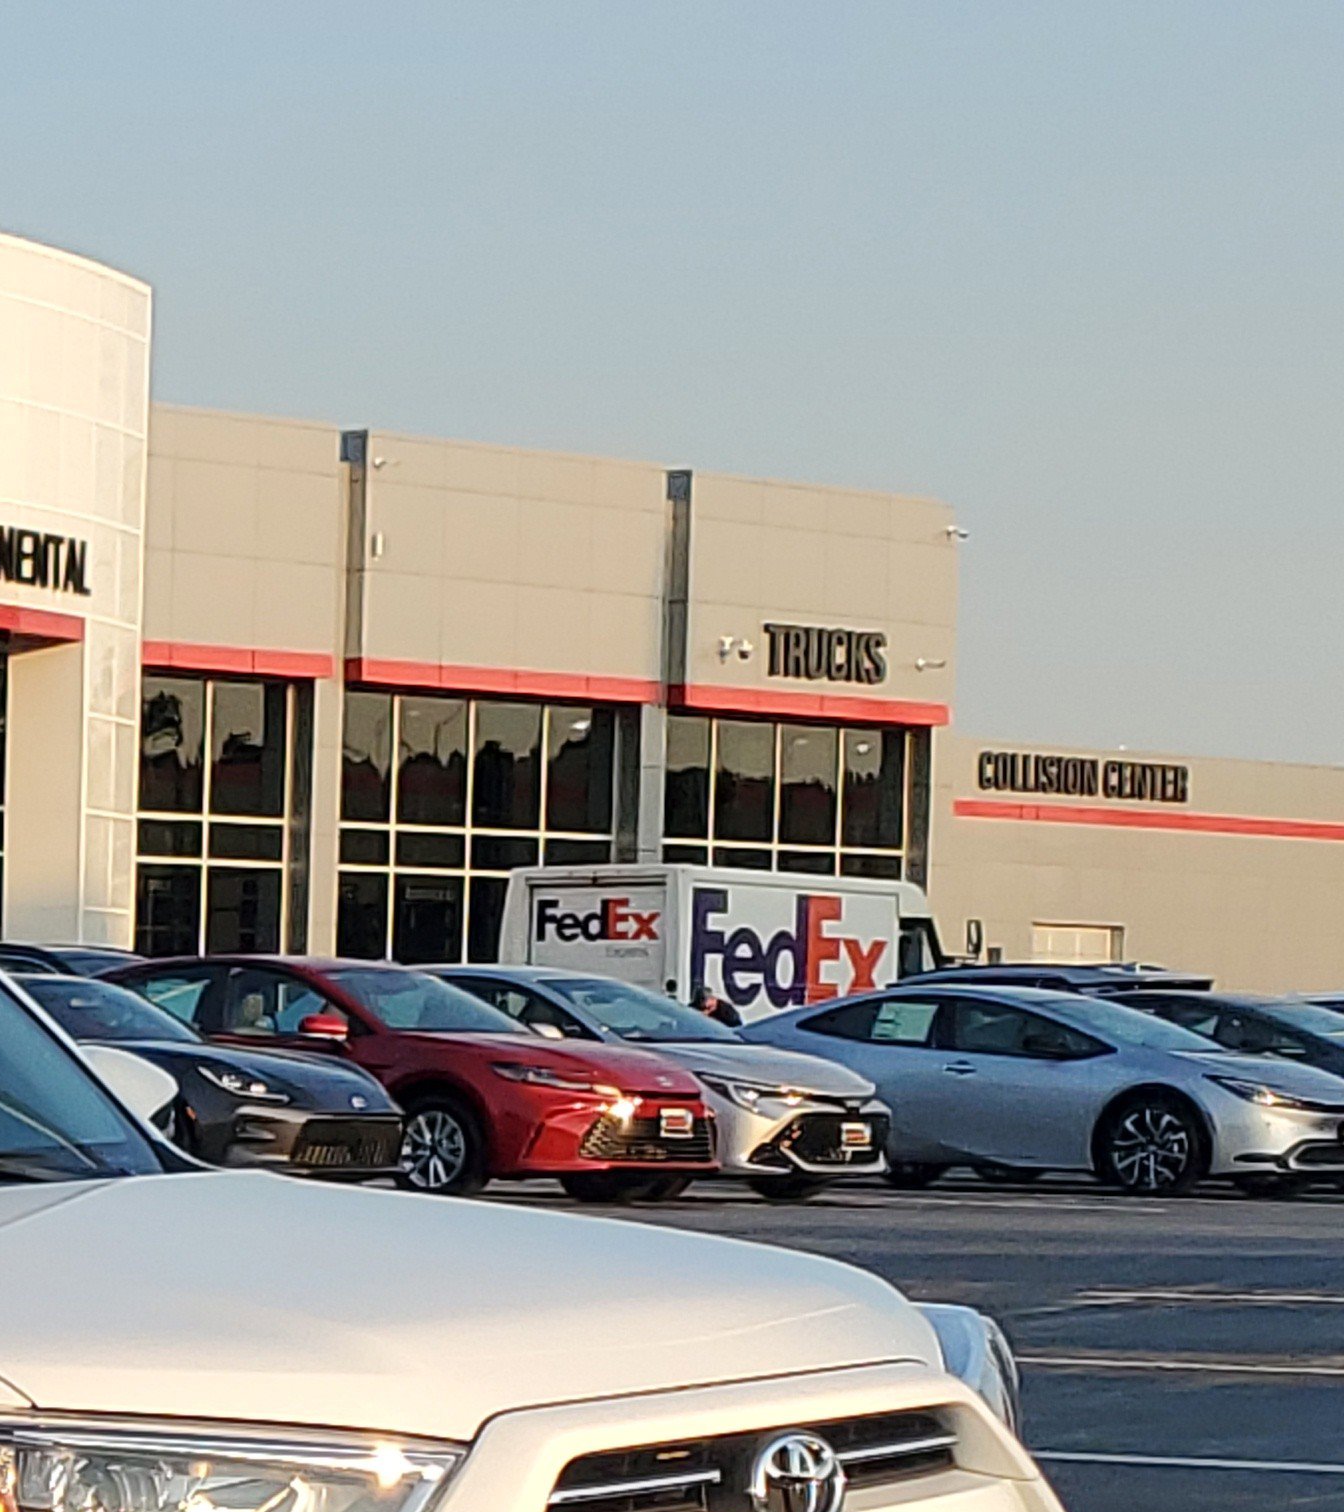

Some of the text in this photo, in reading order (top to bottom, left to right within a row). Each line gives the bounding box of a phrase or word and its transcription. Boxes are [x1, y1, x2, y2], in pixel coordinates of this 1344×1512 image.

[763, 622, 888, 685] TRUCKS
[978, 750, 1189, 803] COLLISION CENTER
[537, 898, 661, 942] FedEx
[692, 886, 888, 1008] FedEx
